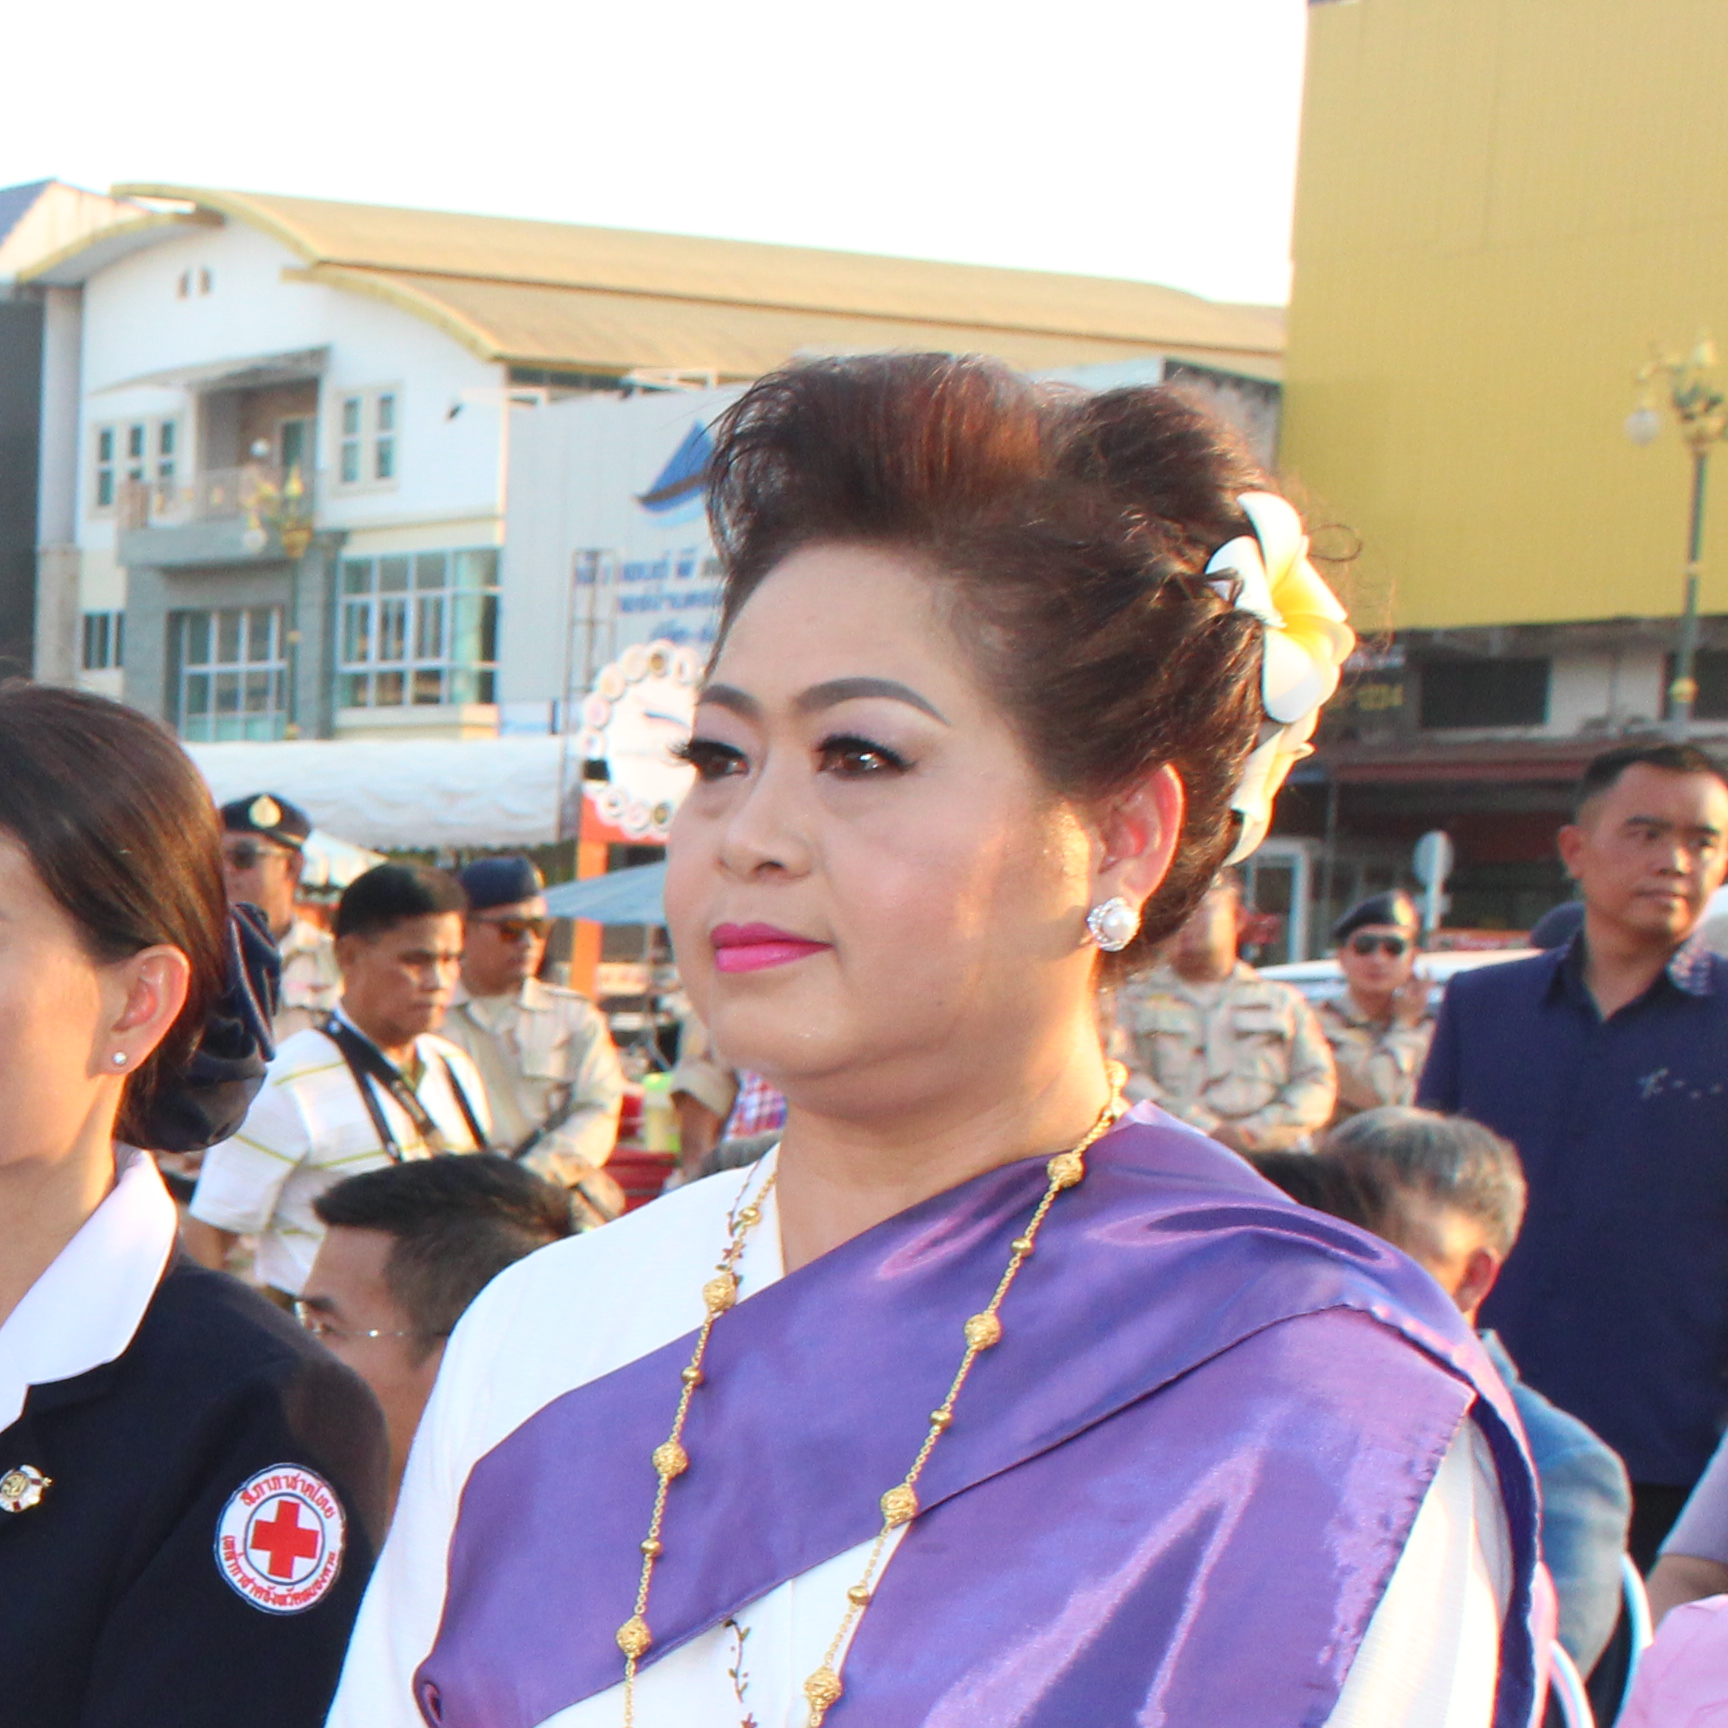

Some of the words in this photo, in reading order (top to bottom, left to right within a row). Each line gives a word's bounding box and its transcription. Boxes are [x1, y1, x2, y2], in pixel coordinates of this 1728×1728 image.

[239, 1472, 336, 1520] สภากาชาดไทย
